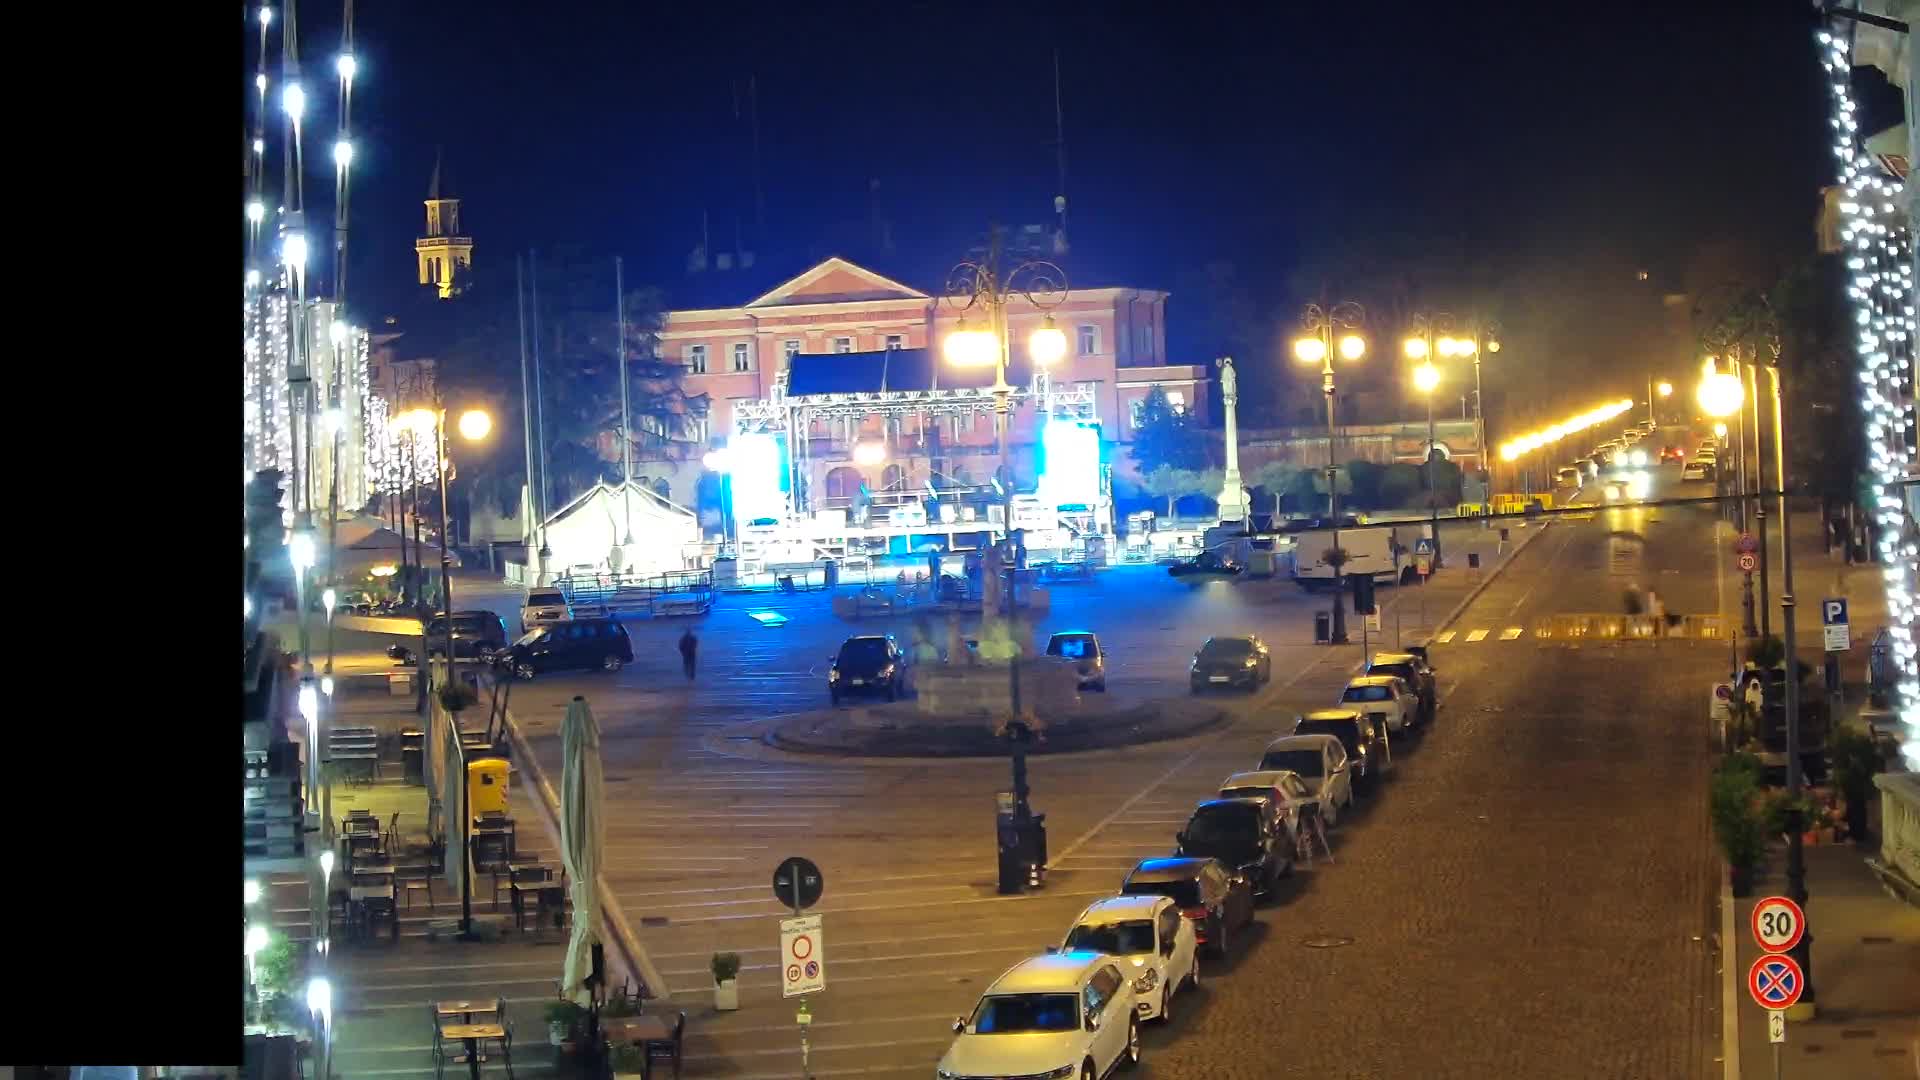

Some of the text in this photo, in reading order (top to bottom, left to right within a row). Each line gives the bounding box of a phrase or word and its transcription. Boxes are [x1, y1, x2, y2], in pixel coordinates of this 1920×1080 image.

[1742, 557, 1753, 567] 20
[1827, 601, 1842, 622] P
[1761, 911, 1792, 938] 30
